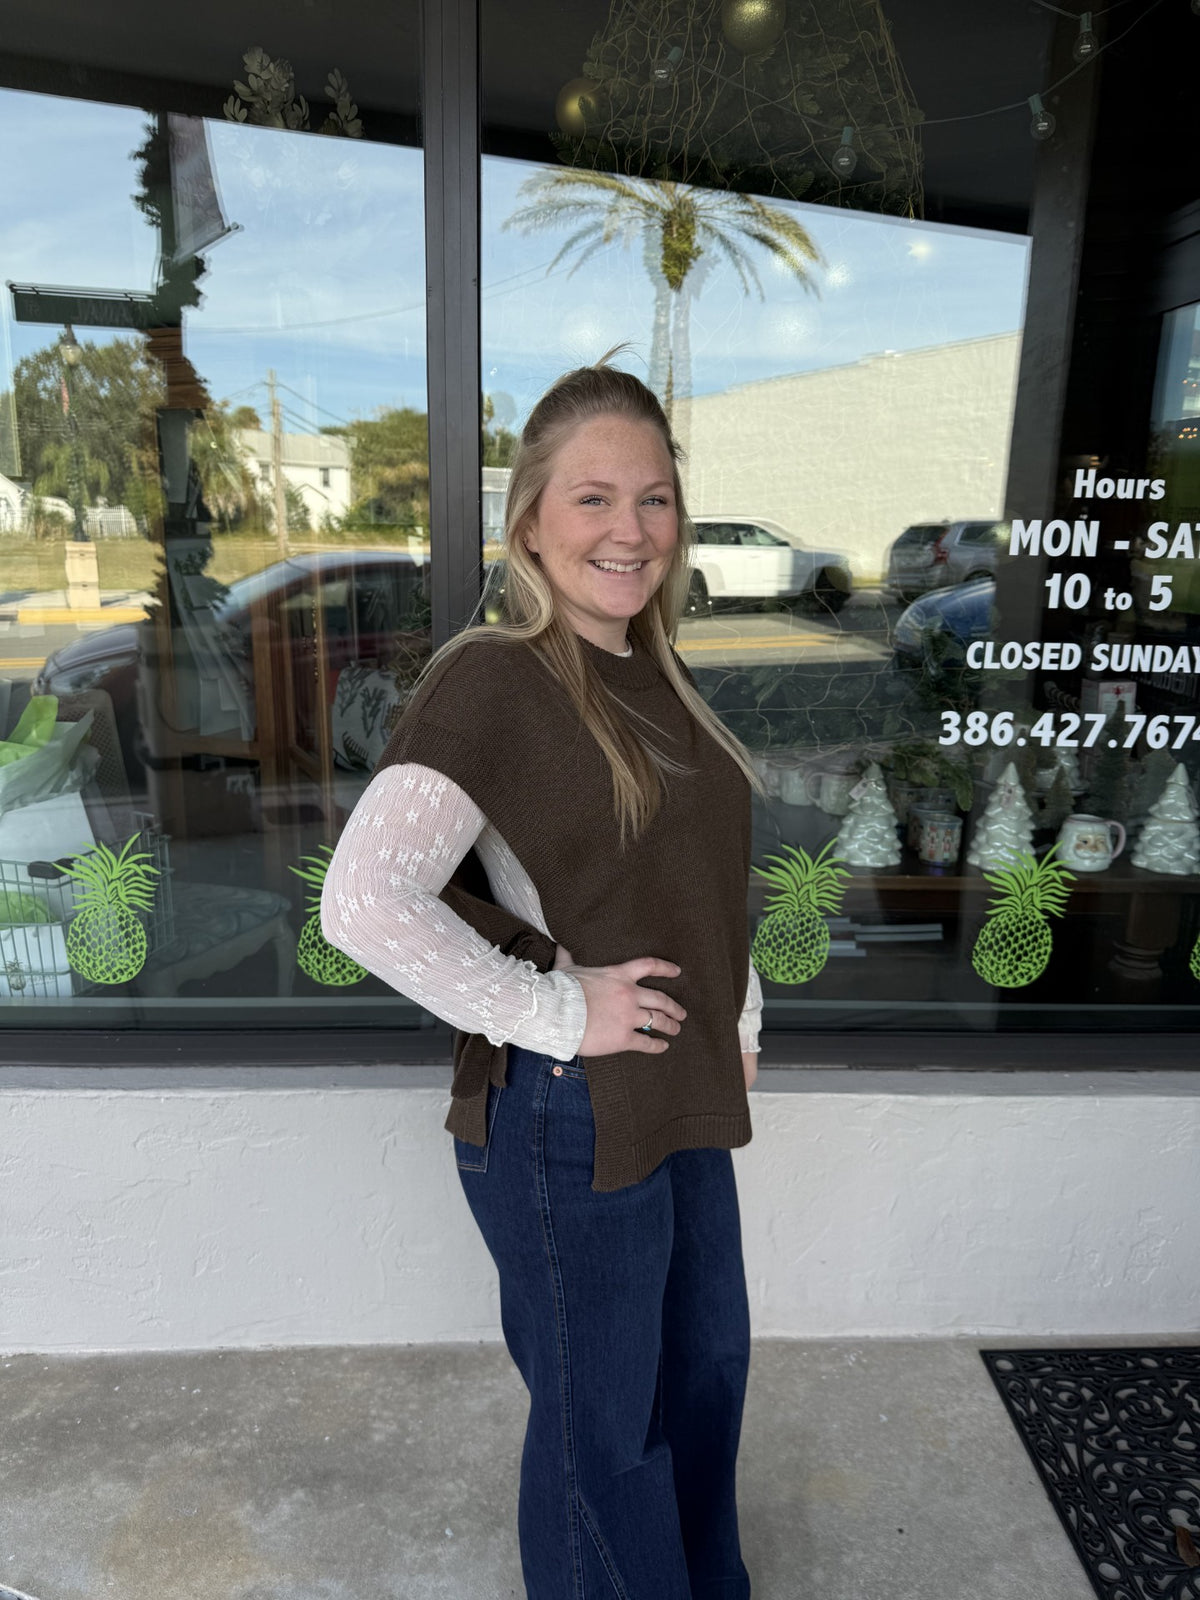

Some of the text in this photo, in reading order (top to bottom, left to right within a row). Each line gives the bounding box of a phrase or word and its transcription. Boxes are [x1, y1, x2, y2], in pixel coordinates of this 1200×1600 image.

[1073, 468, 1166, 500] Hours
[1008, 519, 1200, 559] MON - SA
[1045, 572, 1173, 612] 10 to 5
[966, 640, 1082, 671] CLOSED
